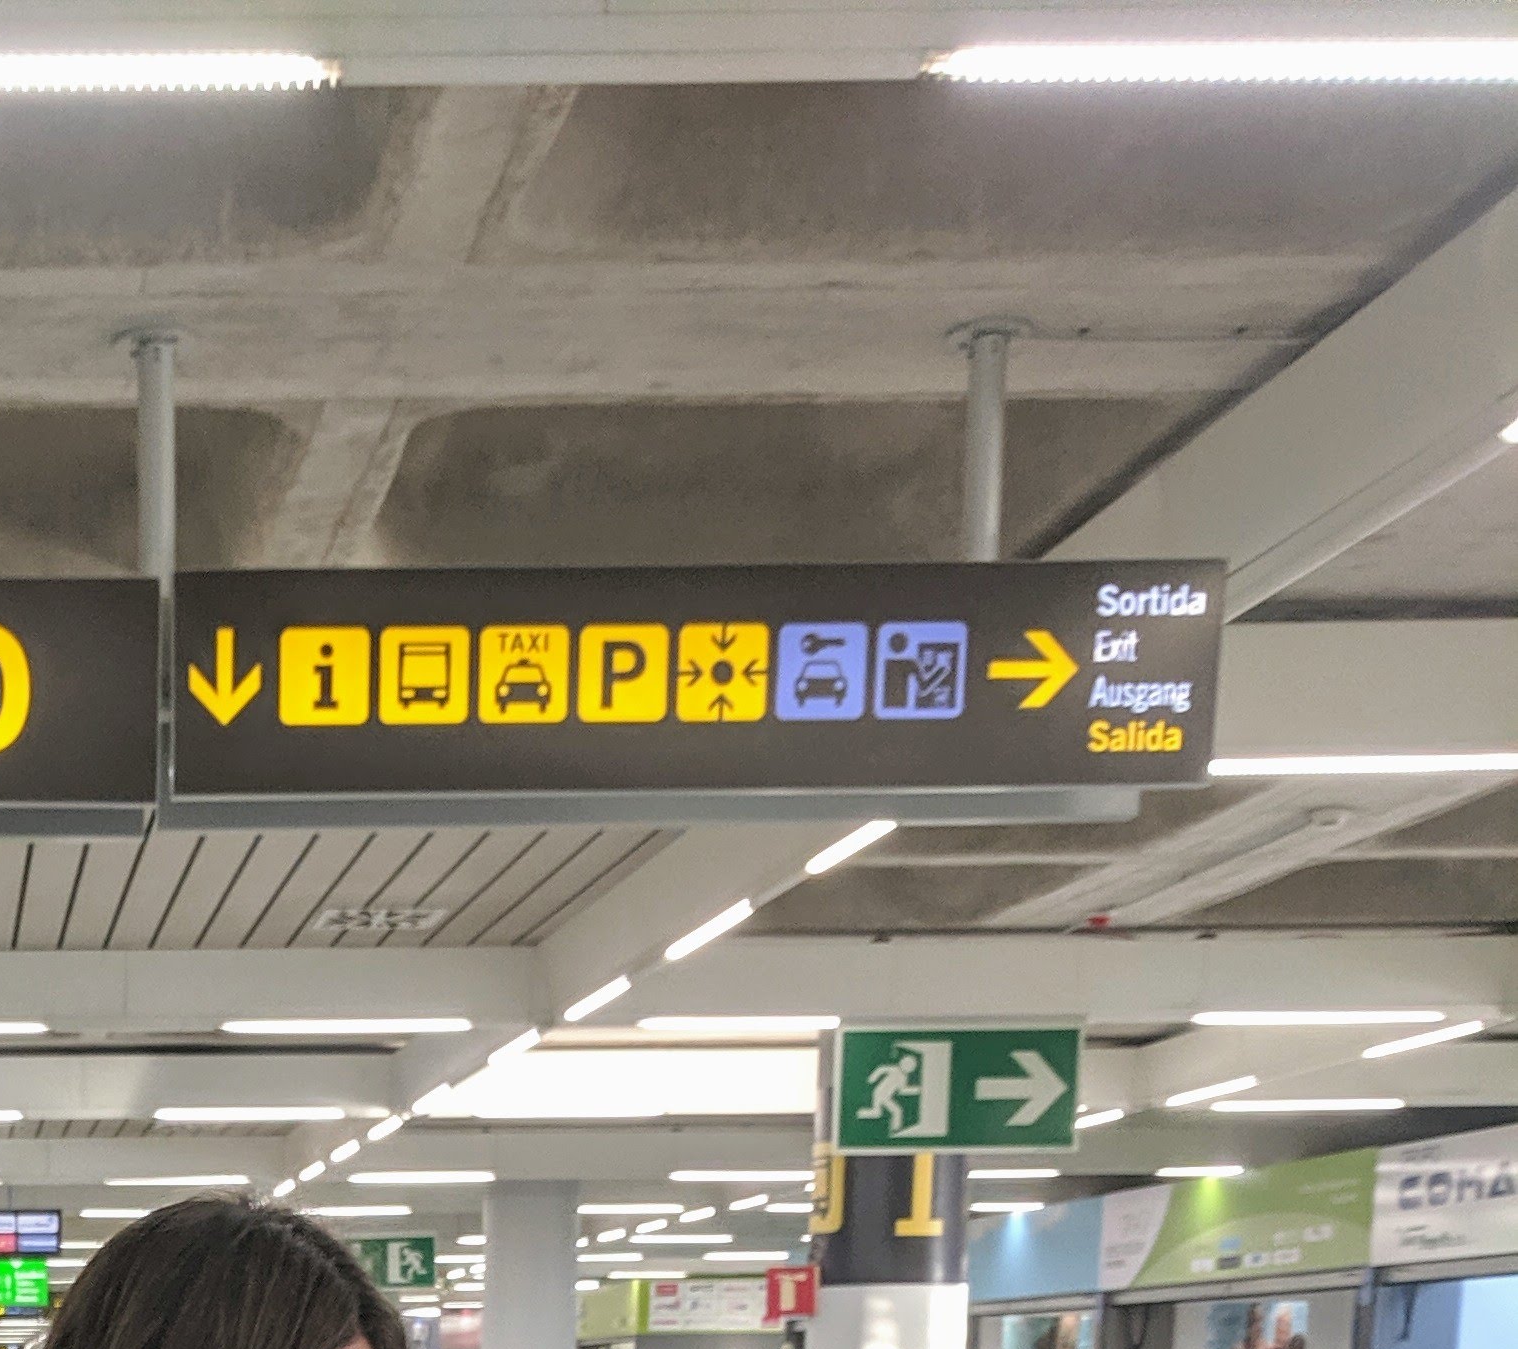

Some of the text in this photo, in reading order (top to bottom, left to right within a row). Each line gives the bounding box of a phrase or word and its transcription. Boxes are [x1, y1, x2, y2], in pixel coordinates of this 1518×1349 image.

[1097, 584, 1208, 617] Sortida
[498, 633, 549, 654] TAXI
[599, 641, 646, 710] P
[1089, 676, 1193, 713] Ausgang
[1088, 720, 1183, 753] Salida
